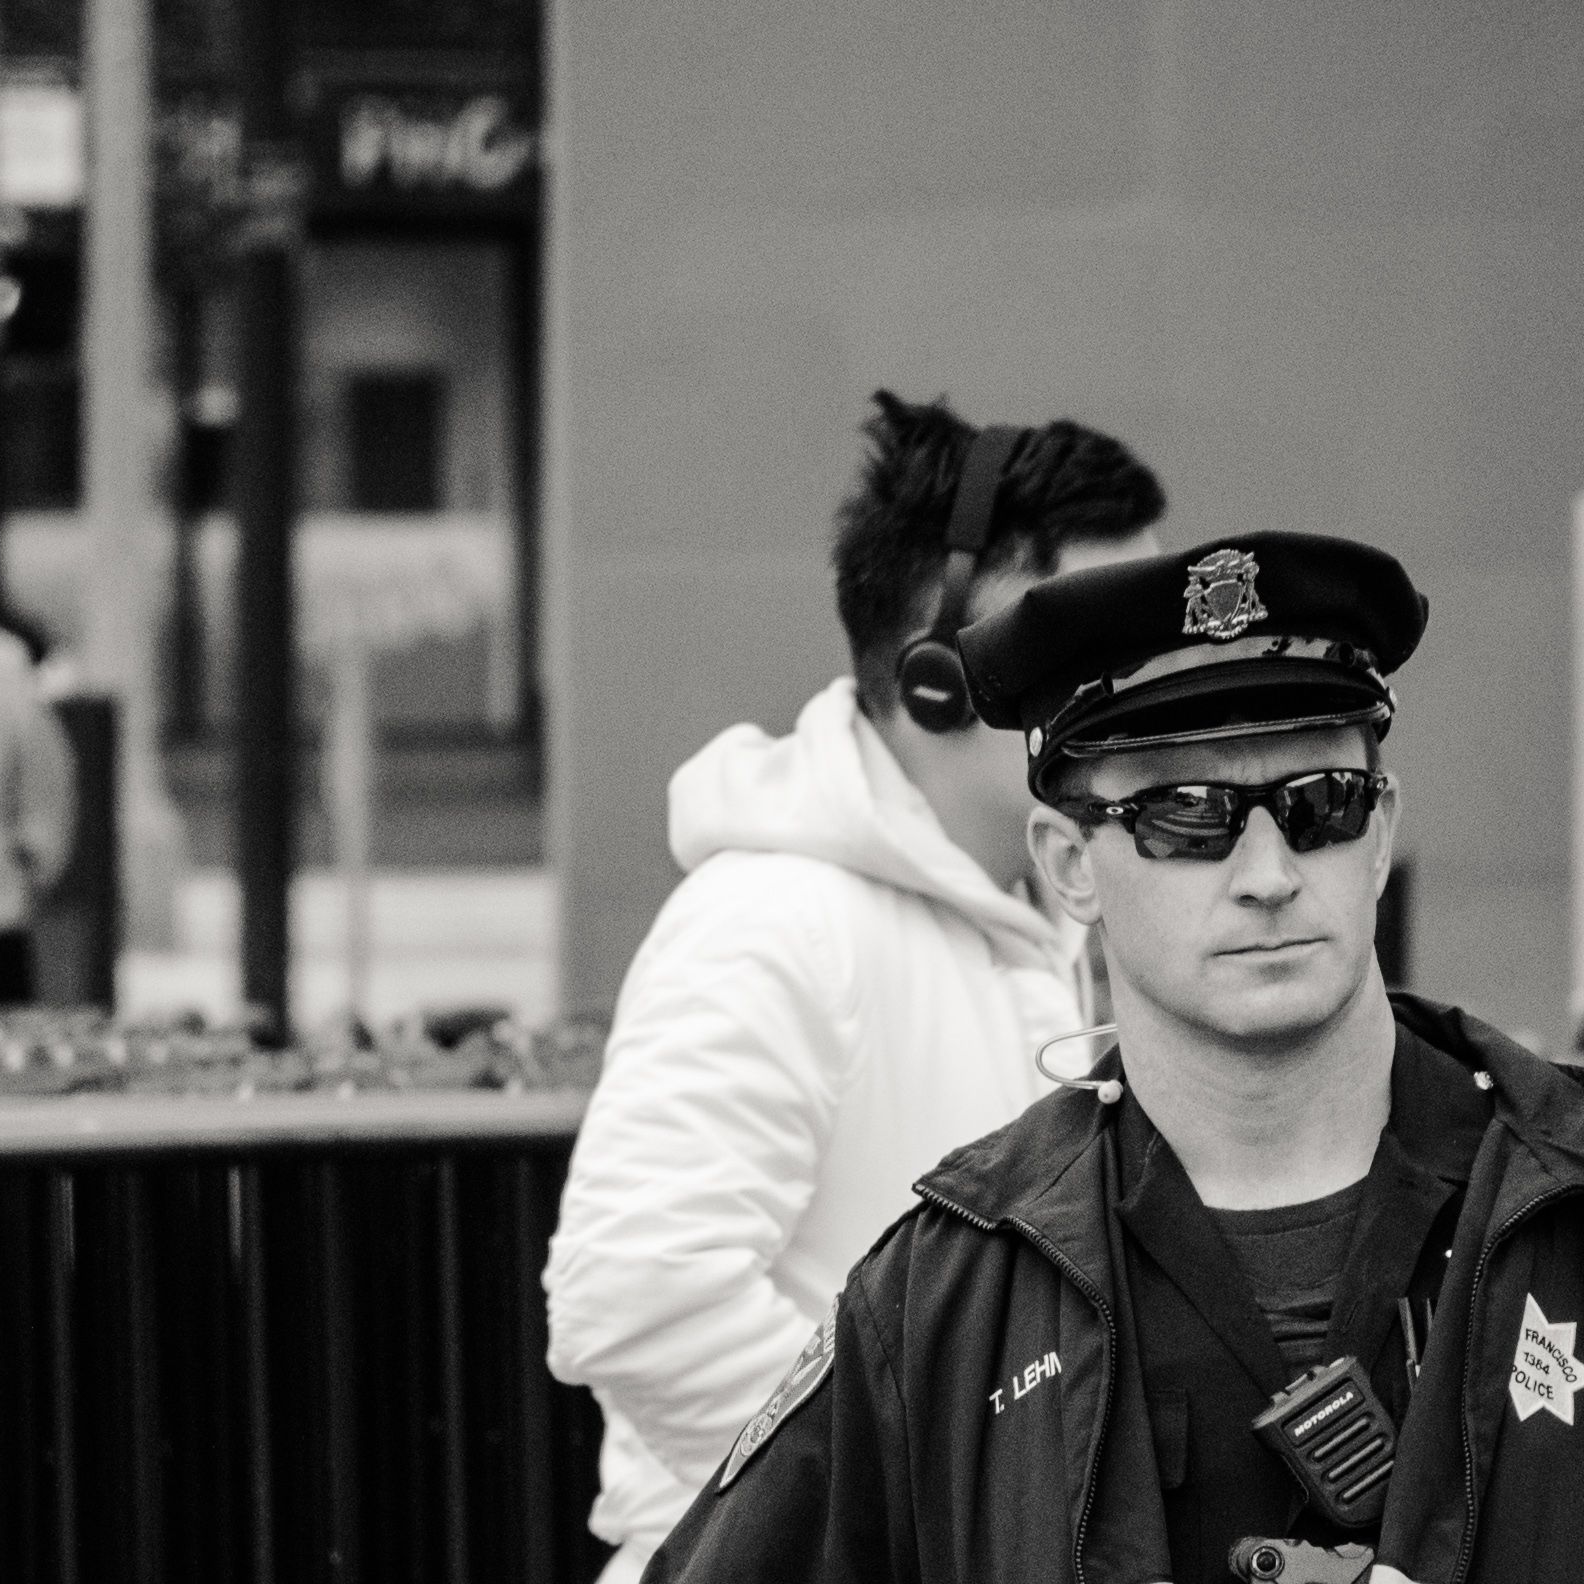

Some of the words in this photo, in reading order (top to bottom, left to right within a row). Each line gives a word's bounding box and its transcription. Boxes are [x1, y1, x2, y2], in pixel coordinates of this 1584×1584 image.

[1524, 1327, 1577, 1383] FRANCISCO
[988, 1388, 1005, 1415] T.
[1294, 1391, 1354, 1437] MOTOROLA
